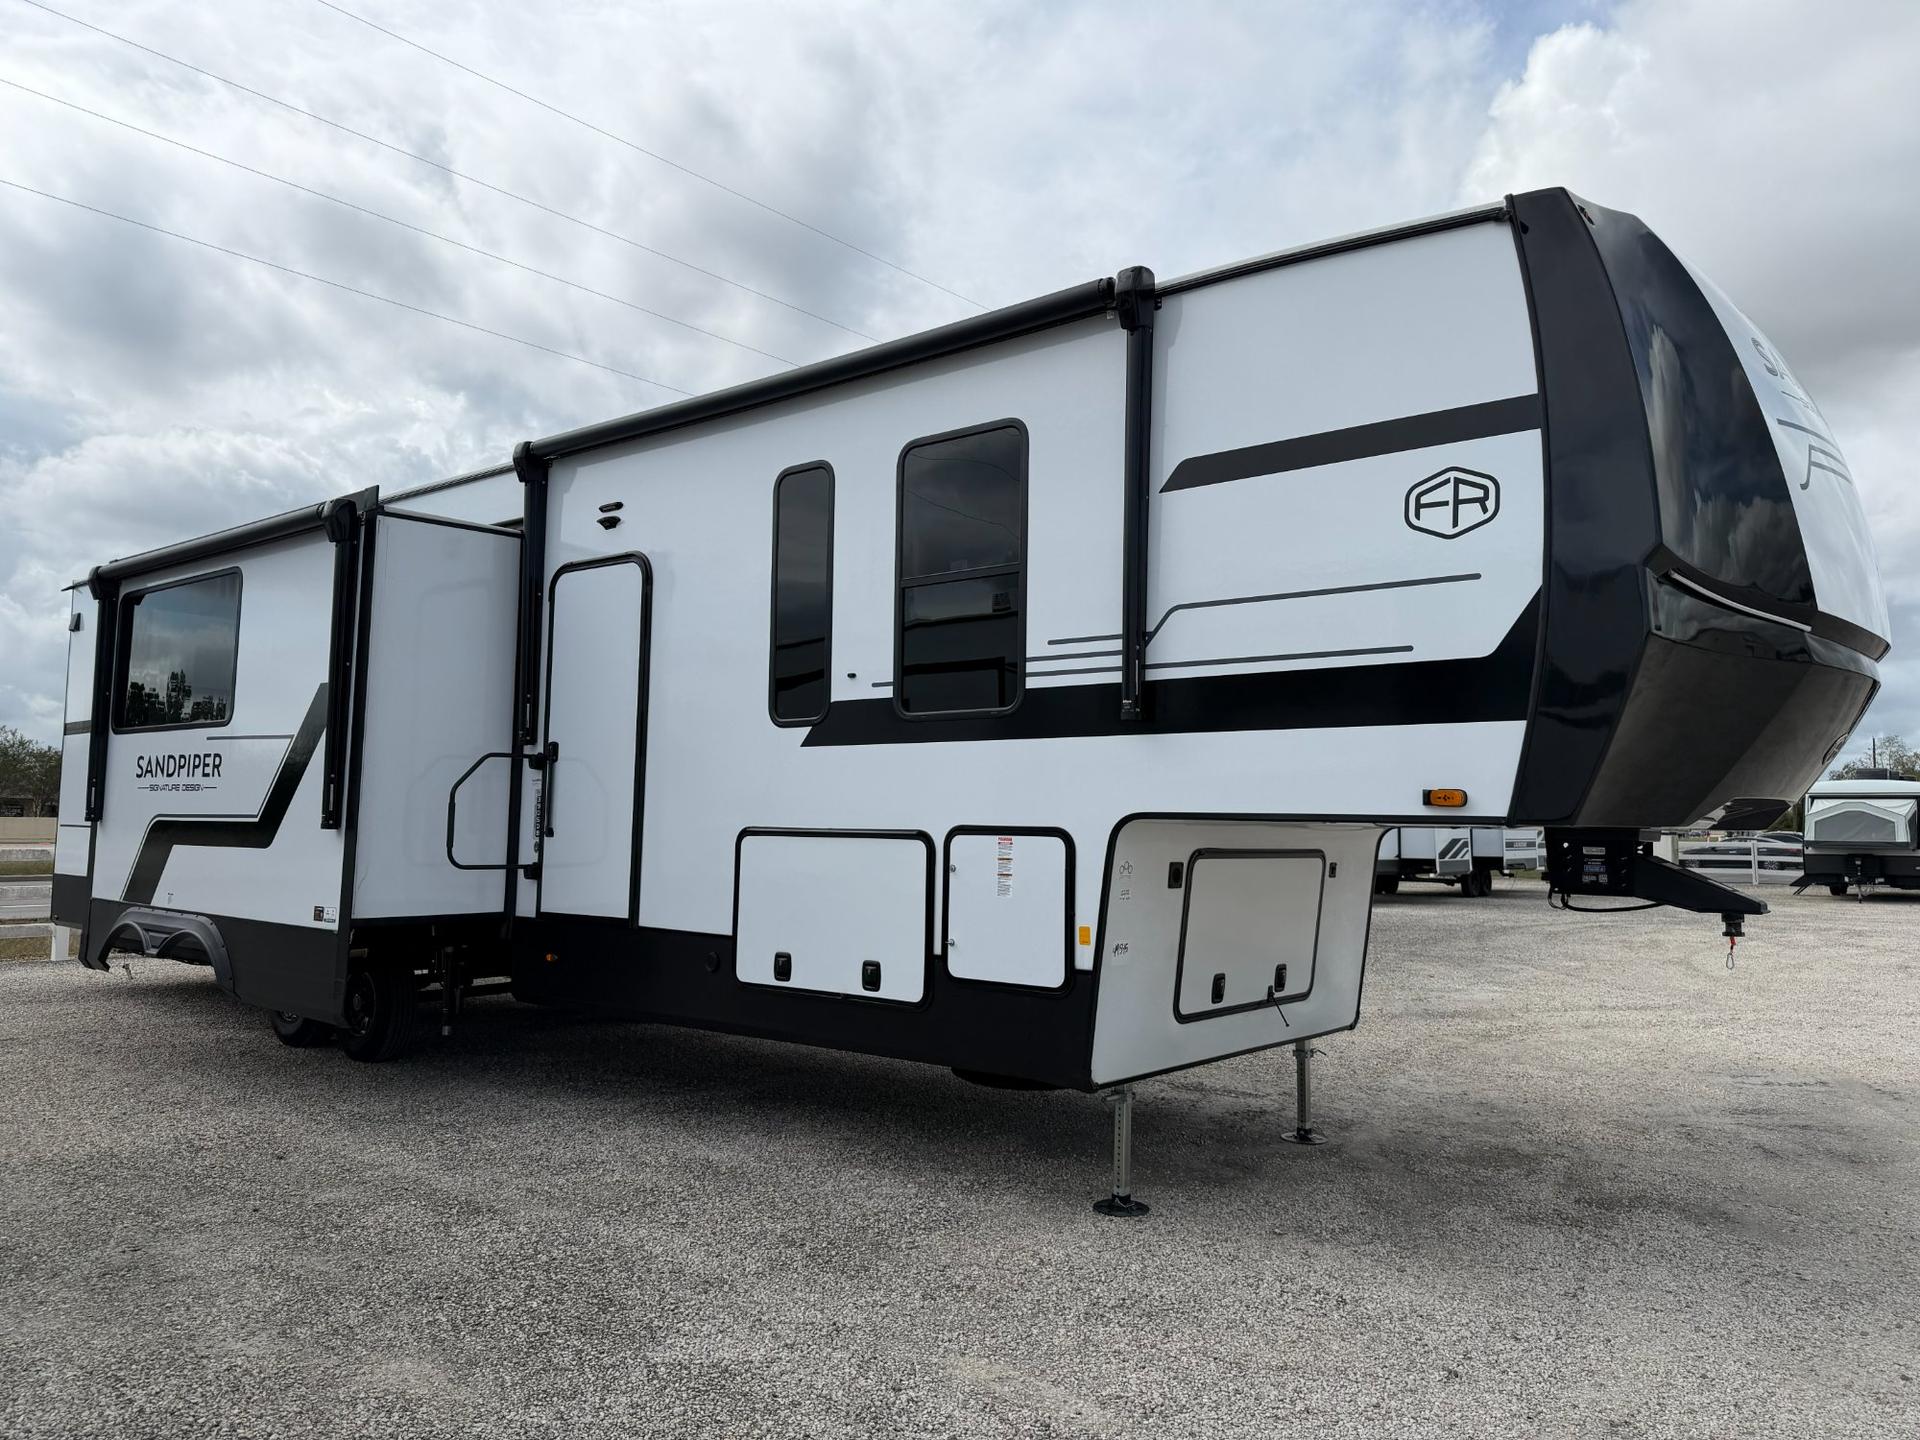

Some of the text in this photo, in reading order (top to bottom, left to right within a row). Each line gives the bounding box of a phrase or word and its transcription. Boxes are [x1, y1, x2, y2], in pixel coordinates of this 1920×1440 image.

[1414, 476, 1490, 529] FR
[135, 753, 223, 779] SANDPIPER
[149, 783, 205, 792] SIGNATURE DESIGN
